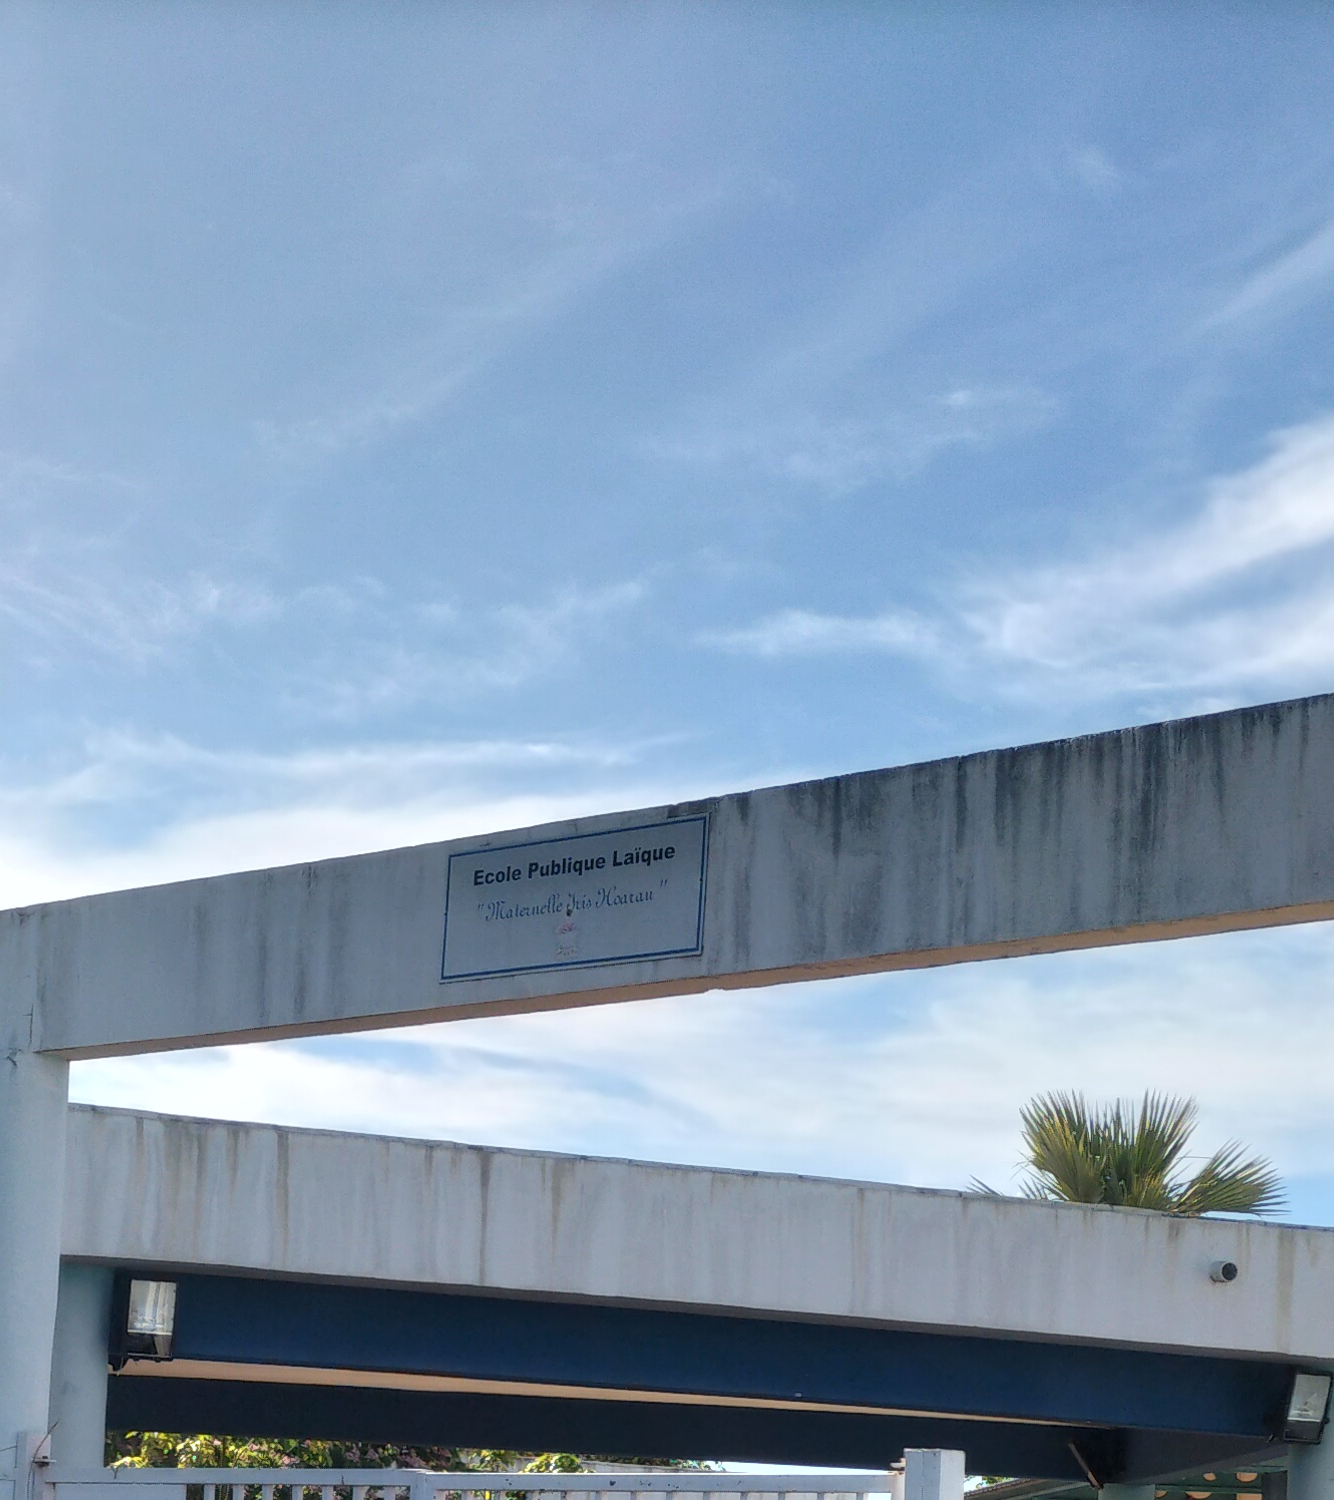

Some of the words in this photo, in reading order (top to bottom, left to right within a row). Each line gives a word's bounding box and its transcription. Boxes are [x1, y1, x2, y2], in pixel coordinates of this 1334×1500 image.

[474, 866, 522, 887] Ecole
[528, 856, 606, 879] Publique
[613, 846, 676, 868] Laïque
